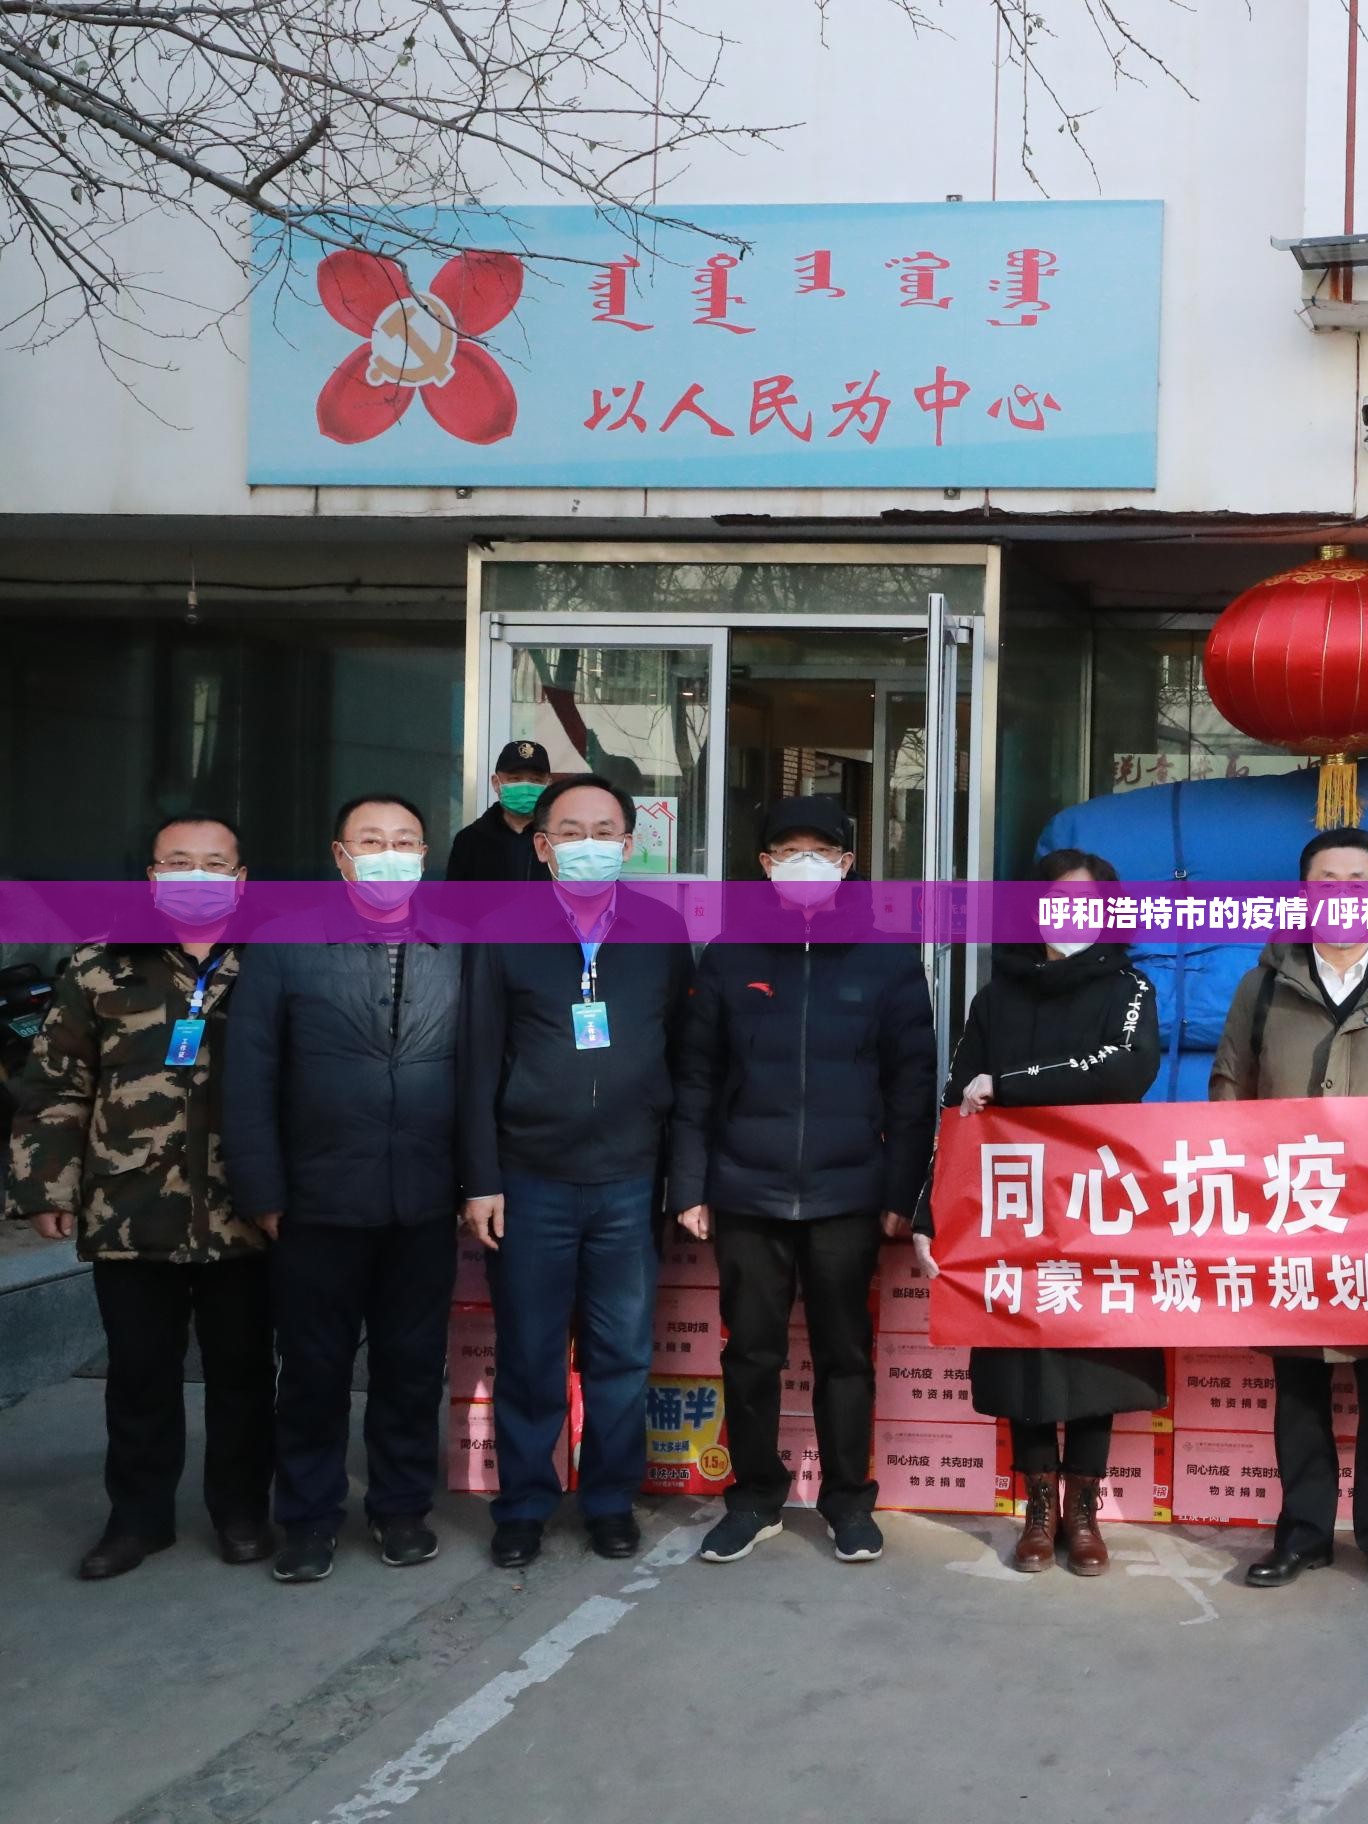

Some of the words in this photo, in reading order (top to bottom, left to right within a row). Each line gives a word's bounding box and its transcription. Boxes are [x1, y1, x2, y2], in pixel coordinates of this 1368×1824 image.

[584, 365, 1061, 446] 以人民为中心
[980, 1134, 1350, 1238] 同心抗疫
[667, 1321, 709, 1334] 共克时艰
[889, 1367, 933, 1380] 同心抗疫
[1187, 1376, 1232, 1389] 同心抗疫
[912, 1388, 968, 1401] 物资捐赠
[1210, 1397, 1268, 1409] 物资捐赠
[886, 1454, 930, 1468] 同心抗疫
[940, 1456, 984, 1469] 共克时艰
[1186, 1464, 1230, 1477] 同心抗疫
[909, 1475, 966, 1489] 物资捐赠
[1208, 1485, 1266, 1498] 物资捐赠
